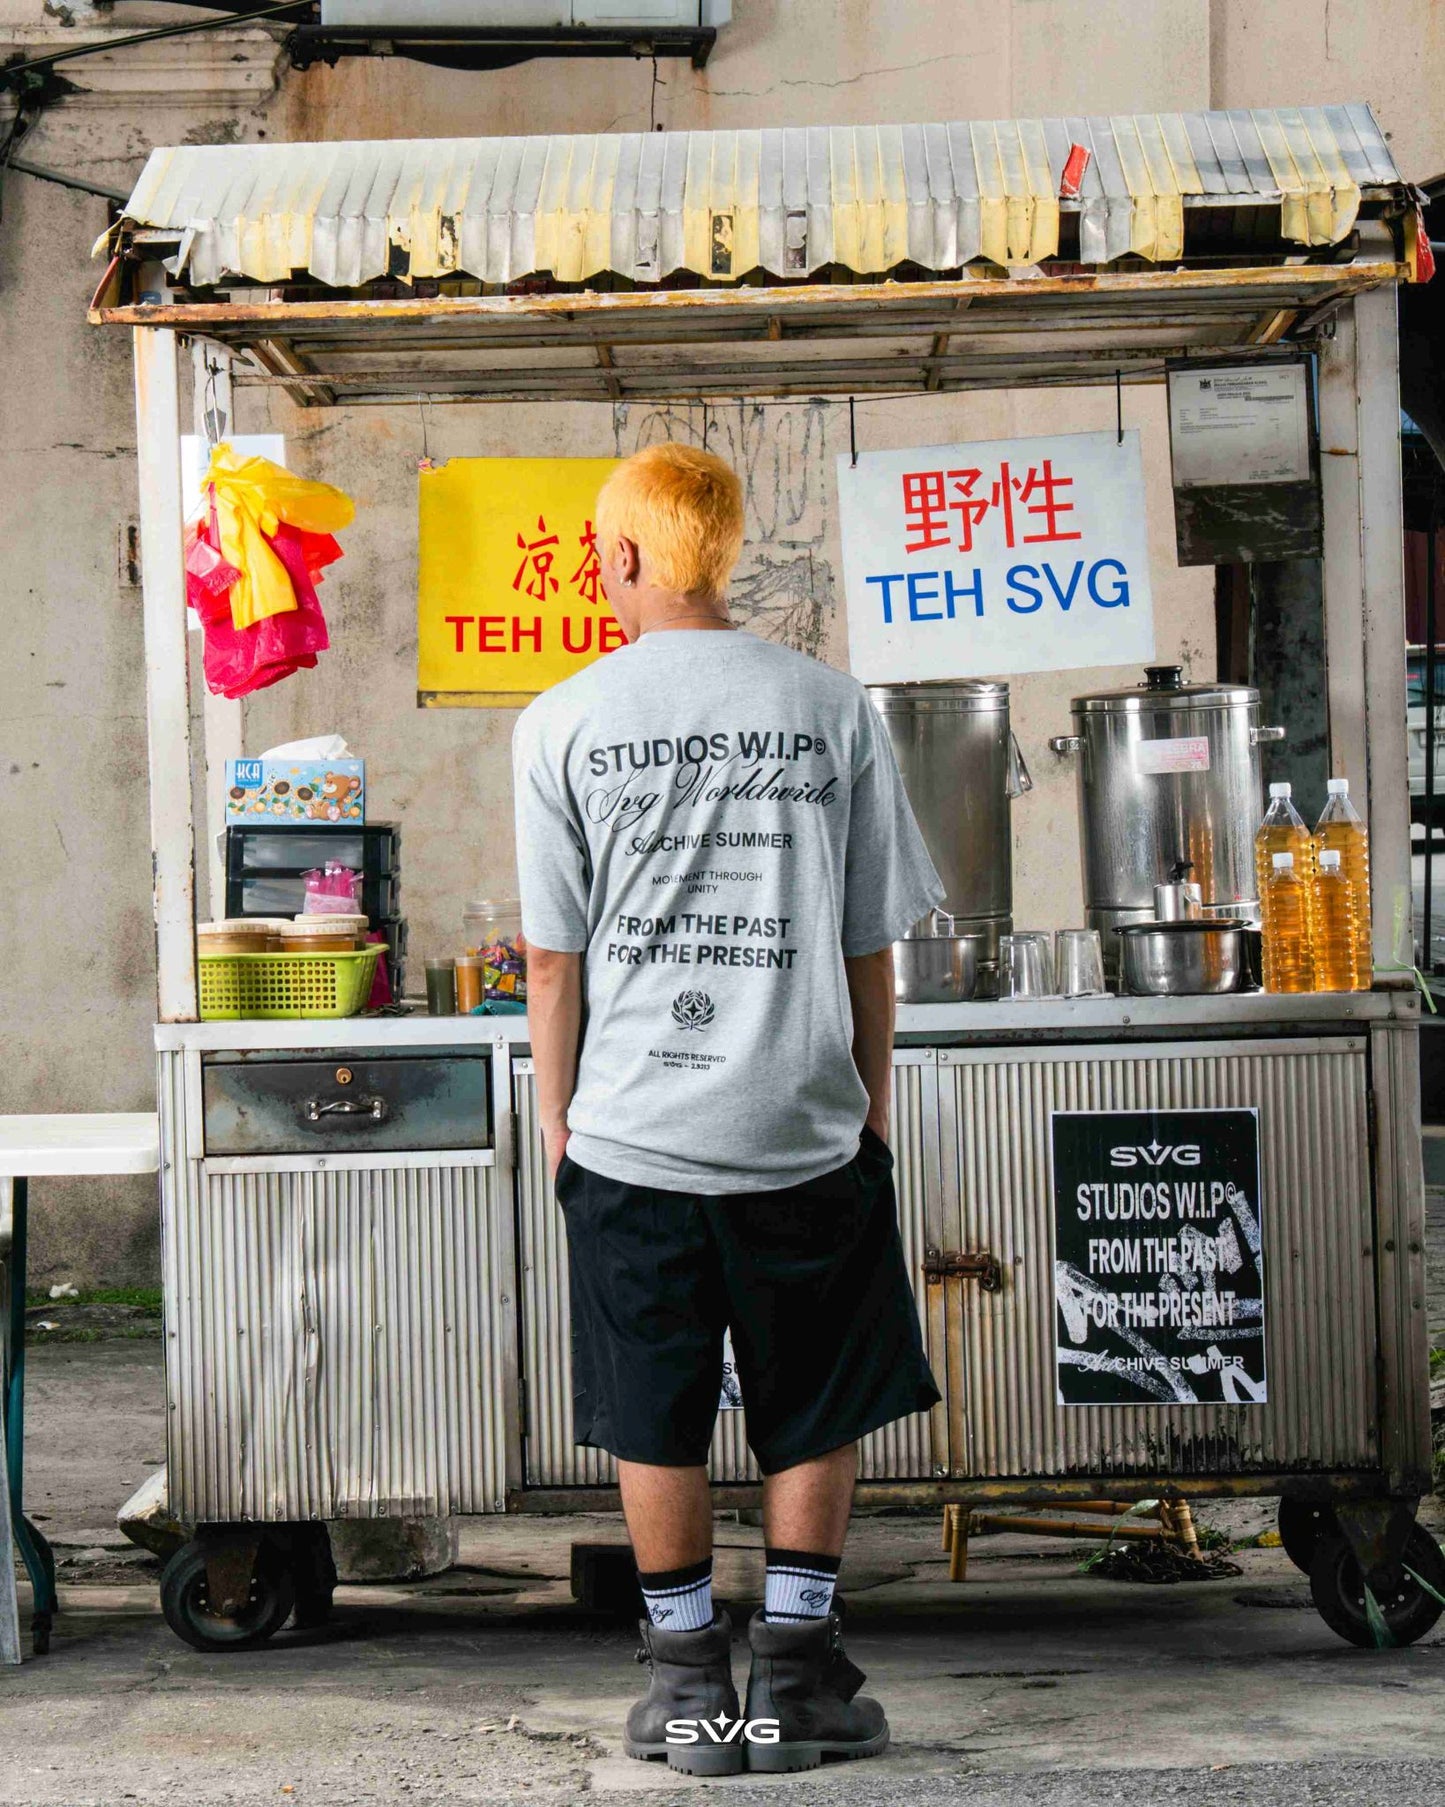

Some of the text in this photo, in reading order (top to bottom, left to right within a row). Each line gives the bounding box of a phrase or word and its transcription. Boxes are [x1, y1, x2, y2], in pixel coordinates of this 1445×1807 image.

[902, 459, 1082, 554] 野性
[865, 558, 1130, 624] TEH SVG
[445, 616, 542, 653] TEH
[589, 733, 730, 777] STUDIOS
[237, 763, 260, 779] KCA
[586, 749, 838, 832] Svg Worldwide
[716, 832, 792, 849] SUMMER
[652, 871, 763, 886] MOVEMENT THROUGH
[687, 885, 719, 894] UNITY
[616, 914, 791, 939] FROM THE PAST
[607, 943, 798, 969] FOR THE PRESENT
[648, 1050, 727, 1063] ALL RIGHTS RESERVED
[1110, 1140, 1200, 1167] SVG
[1077, 1182, 1171, 1221] STUDIOS
[1088, 1237, 1228, 1274] FROM THE PAST
[1084, 1291, 1236, 1328] FOR THE PRESENT
[1170, 1356, 1244, 1370] SUMER
